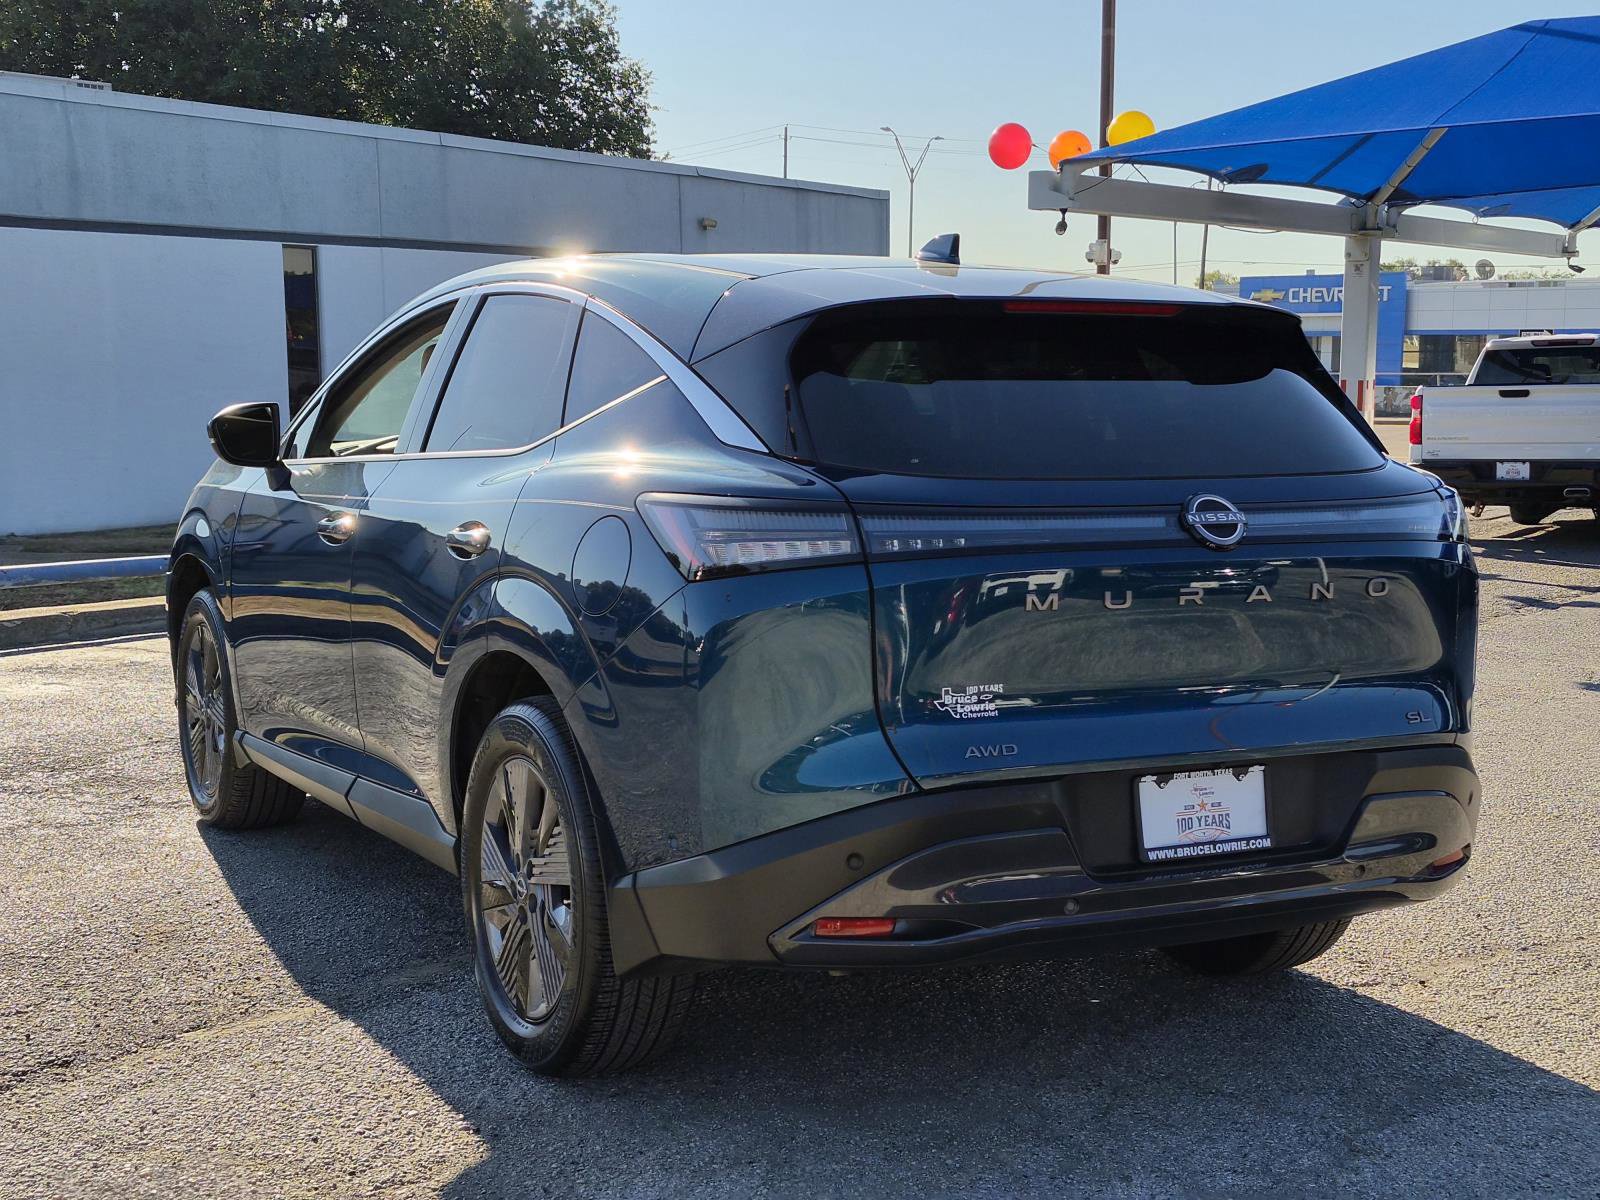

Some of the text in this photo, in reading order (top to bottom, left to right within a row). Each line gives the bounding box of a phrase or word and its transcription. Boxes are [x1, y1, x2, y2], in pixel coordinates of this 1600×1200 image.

[1288, 285, 1392, 303] CHEVRT
[1187, 513, 1246, 522] NISSAN
[1025, 577, 1389, 611] MURANO
[966, 684, 1004, 695] 100 YEARS
[944, 694, 978, 704] Bruce
[957, 701, 996, 713] Lowrie
[962, 710, 999, 719] Chevrolet
[1407, 711, 1432, 724] SL
[964, 744, 1018, 759] AWD
[1173, 772, 1189, 780] FORT
[1214, 768, 1233, 777] TEXAS
[1176, 812, 1231, 835] 100 YEARS
[1147, 838, 1272, 860] WWW.BRUCELOWRIE.COM
